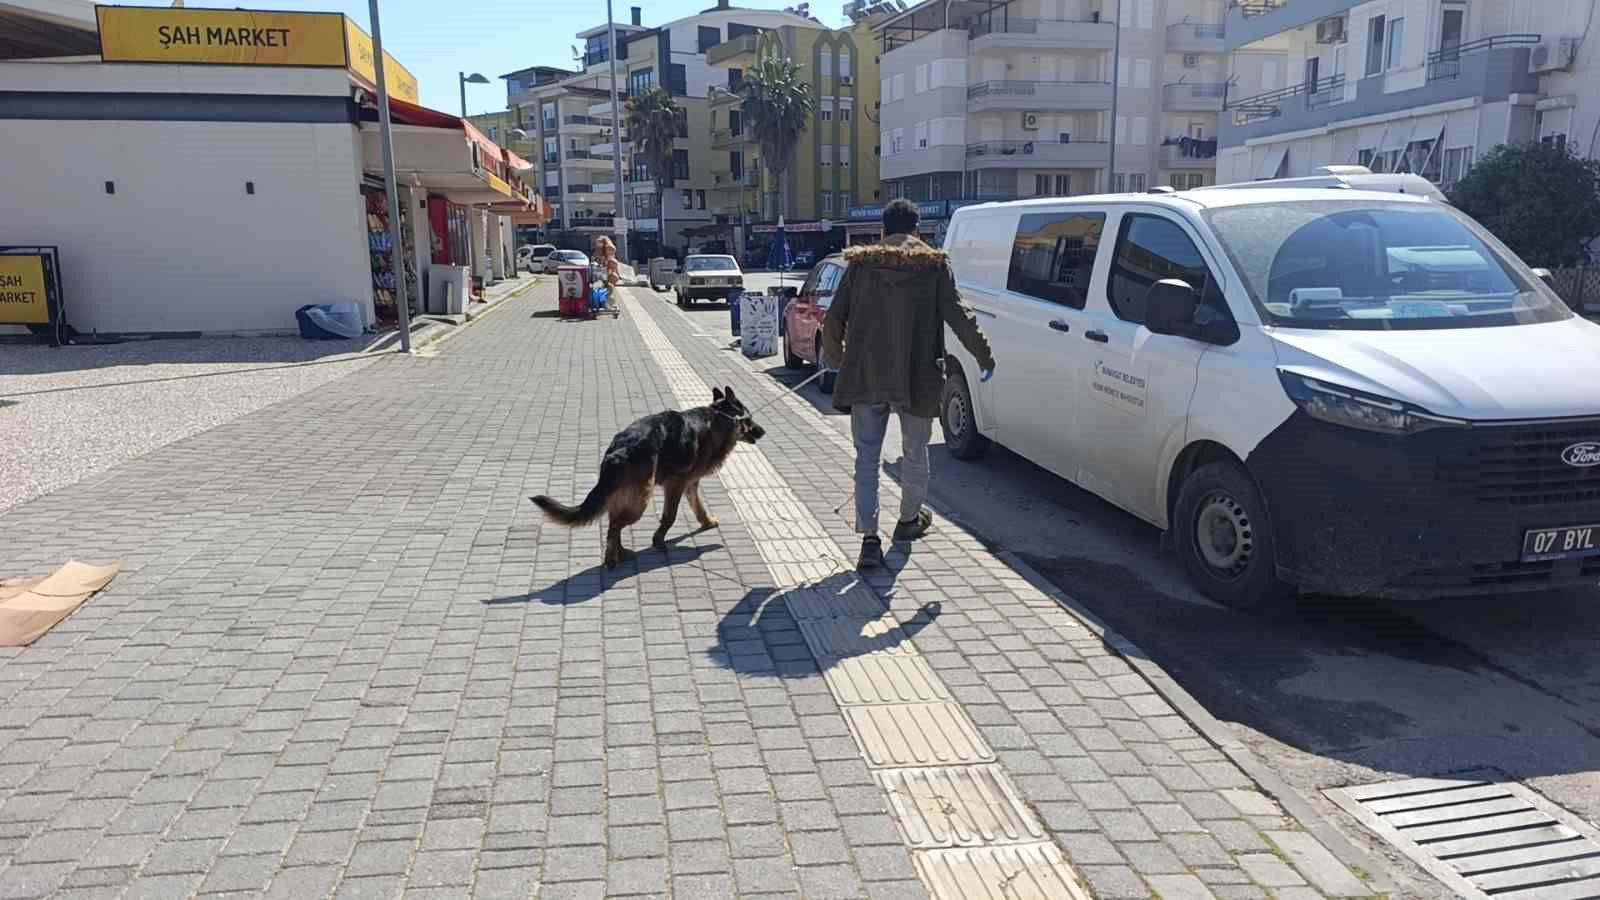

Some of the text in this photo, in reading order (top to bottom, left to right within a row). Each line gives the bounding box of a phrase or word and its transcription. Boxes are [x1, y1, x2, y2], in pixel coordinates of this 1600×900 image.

[158, 25, 290, 49] ŞAH MARKET
[0, 291, 36, 303] ARKET
[1534, 528, 1594, 553] 07 BYL
